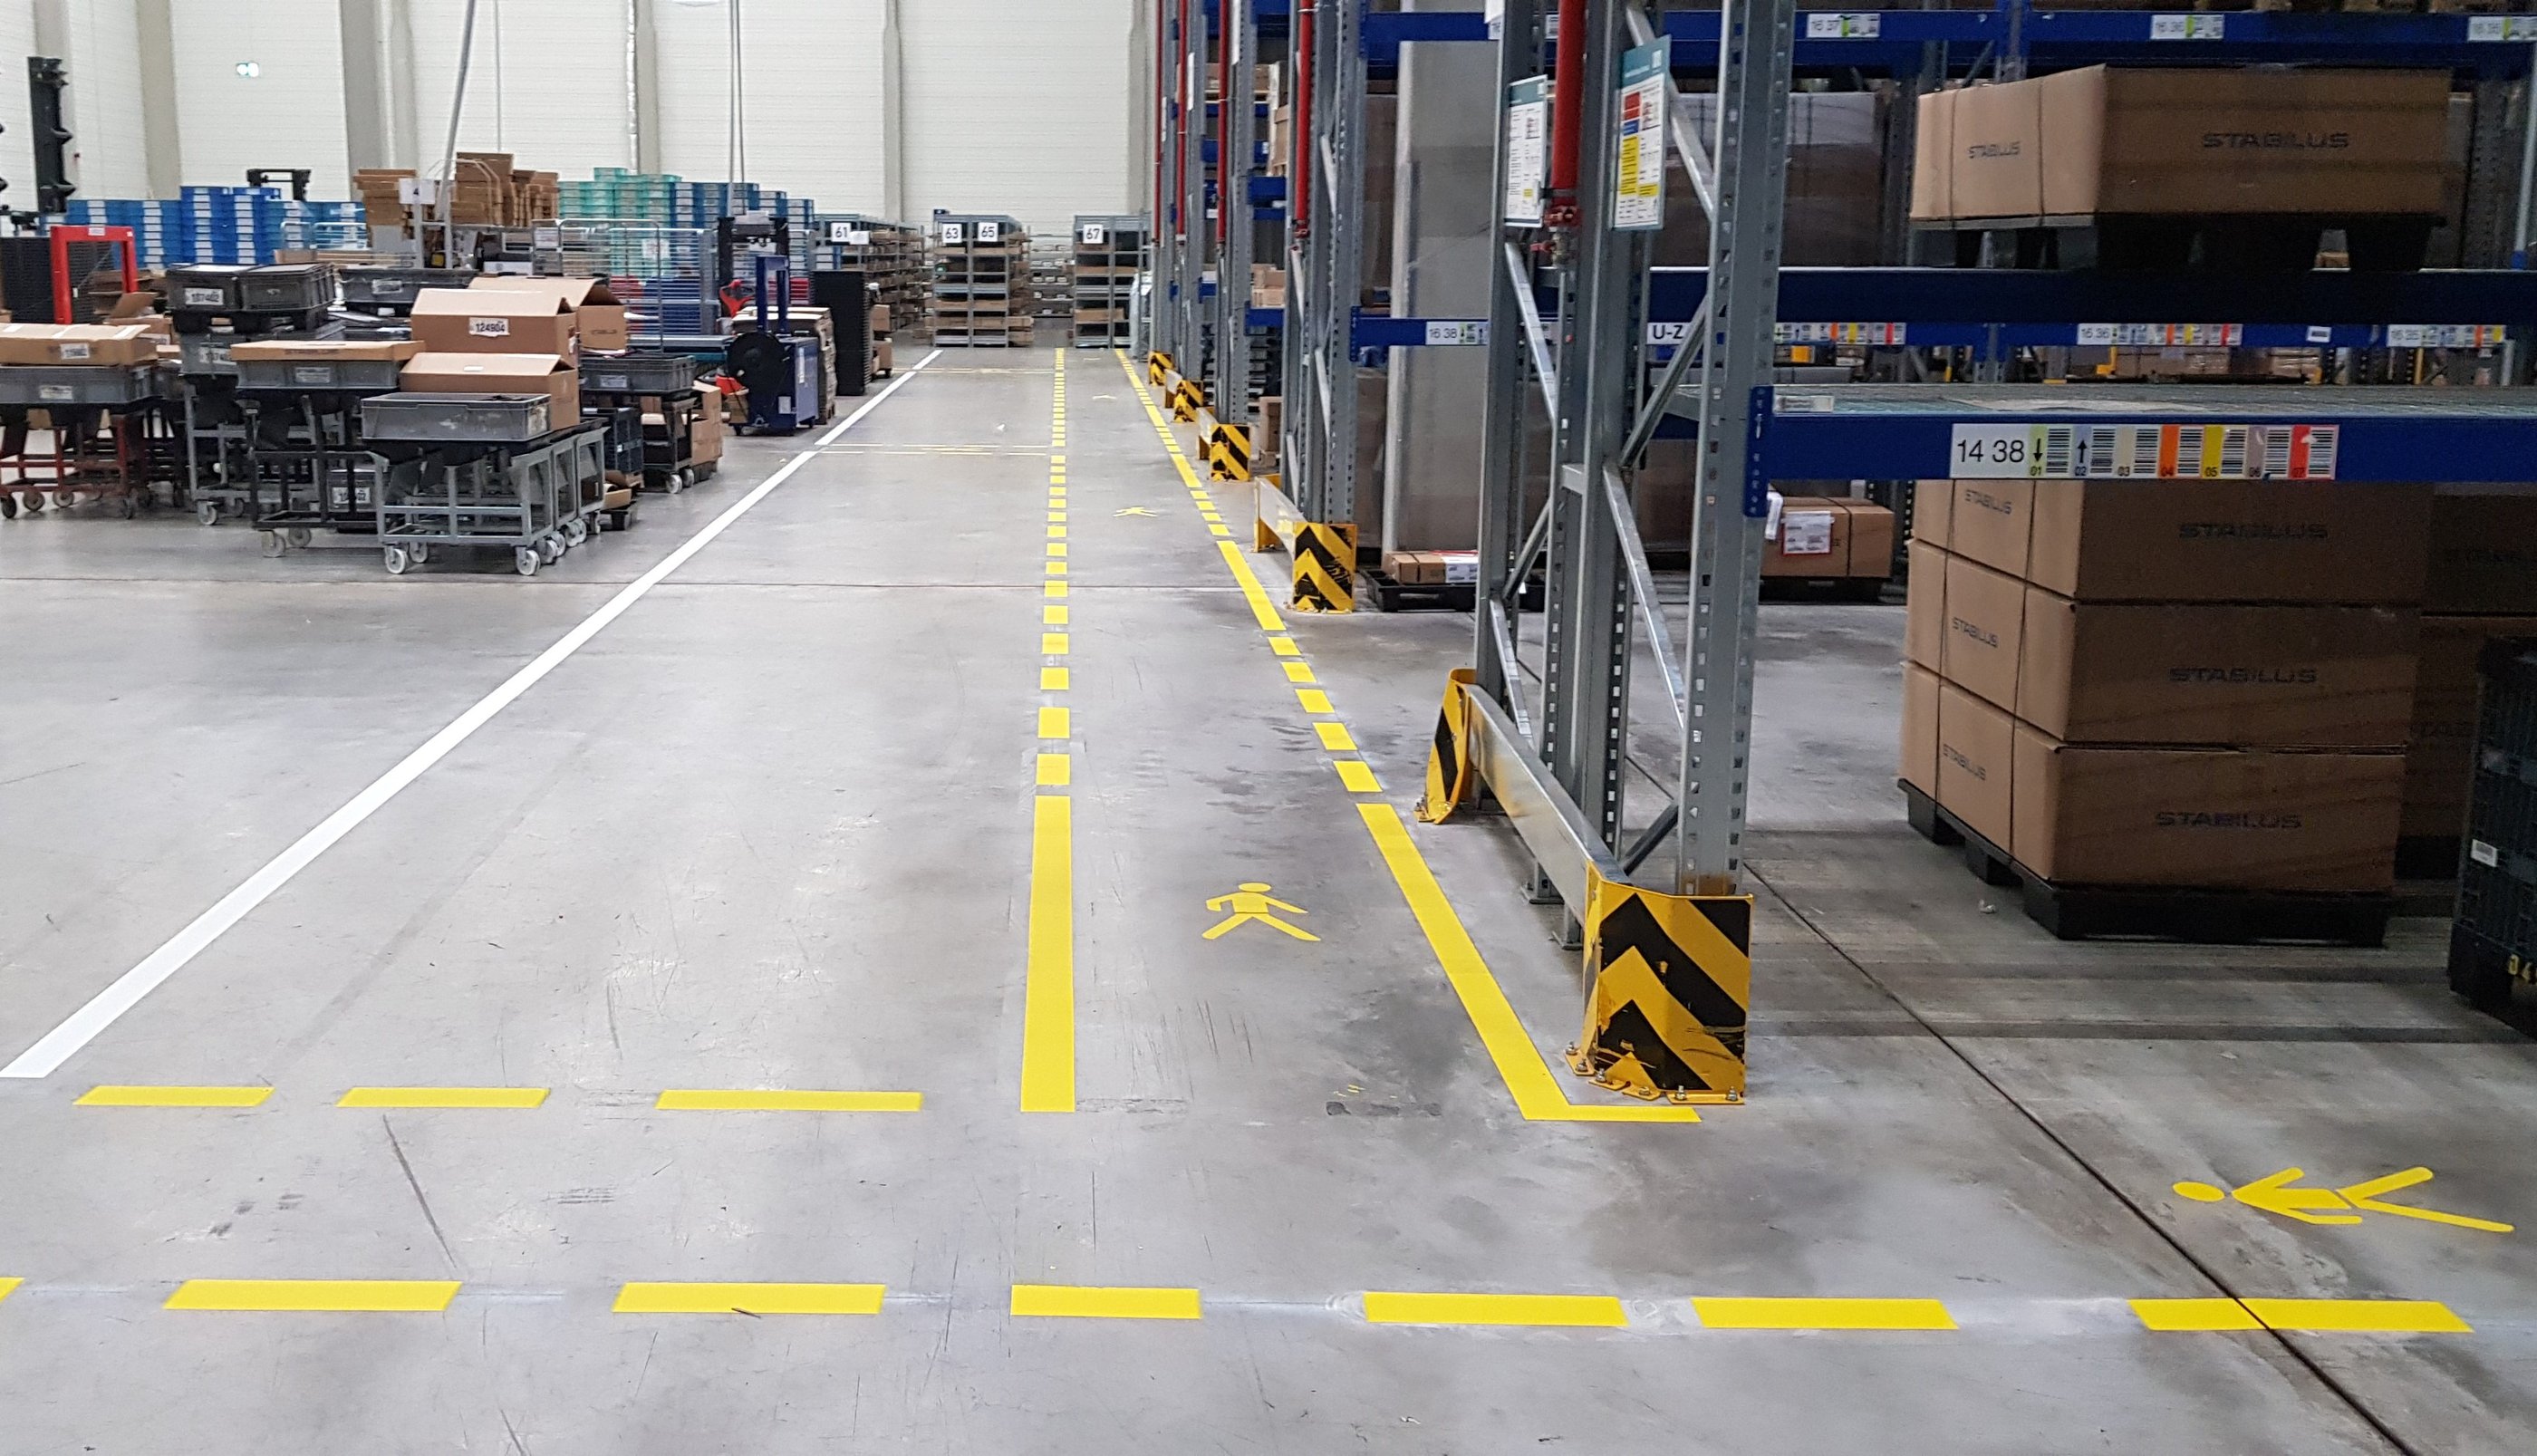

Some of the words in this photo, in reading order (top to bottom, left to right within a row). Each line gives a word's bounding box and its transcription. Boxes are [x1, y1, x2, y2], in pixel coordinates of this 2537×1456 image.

[2203, 132, 2349, 149] STABILUS
[835, 227, 847, 238] 61
[945, 227, 959, 239] 63
[981, 226, 995, 237] 65
[1086, 227, 1100, 239] 67
[1653, 324, 1683, 340] U-Z
[1957, 439, 1983, 463] 14
[1992, 439, 2024, 463] 38
[2030, 466, 2042, 477] 01
[2075, 466, 2087, 477] 02
[2117, 466, 2130, 477] 03
[2161, 467, 2174, 477] 04
[2204, 467, 2218, 477] 05
[2249, 467, 2262, 477] 06
[2169, 667, 2317, 683] STABILUS
[2156, 811, 2302, 829] STABILUS
